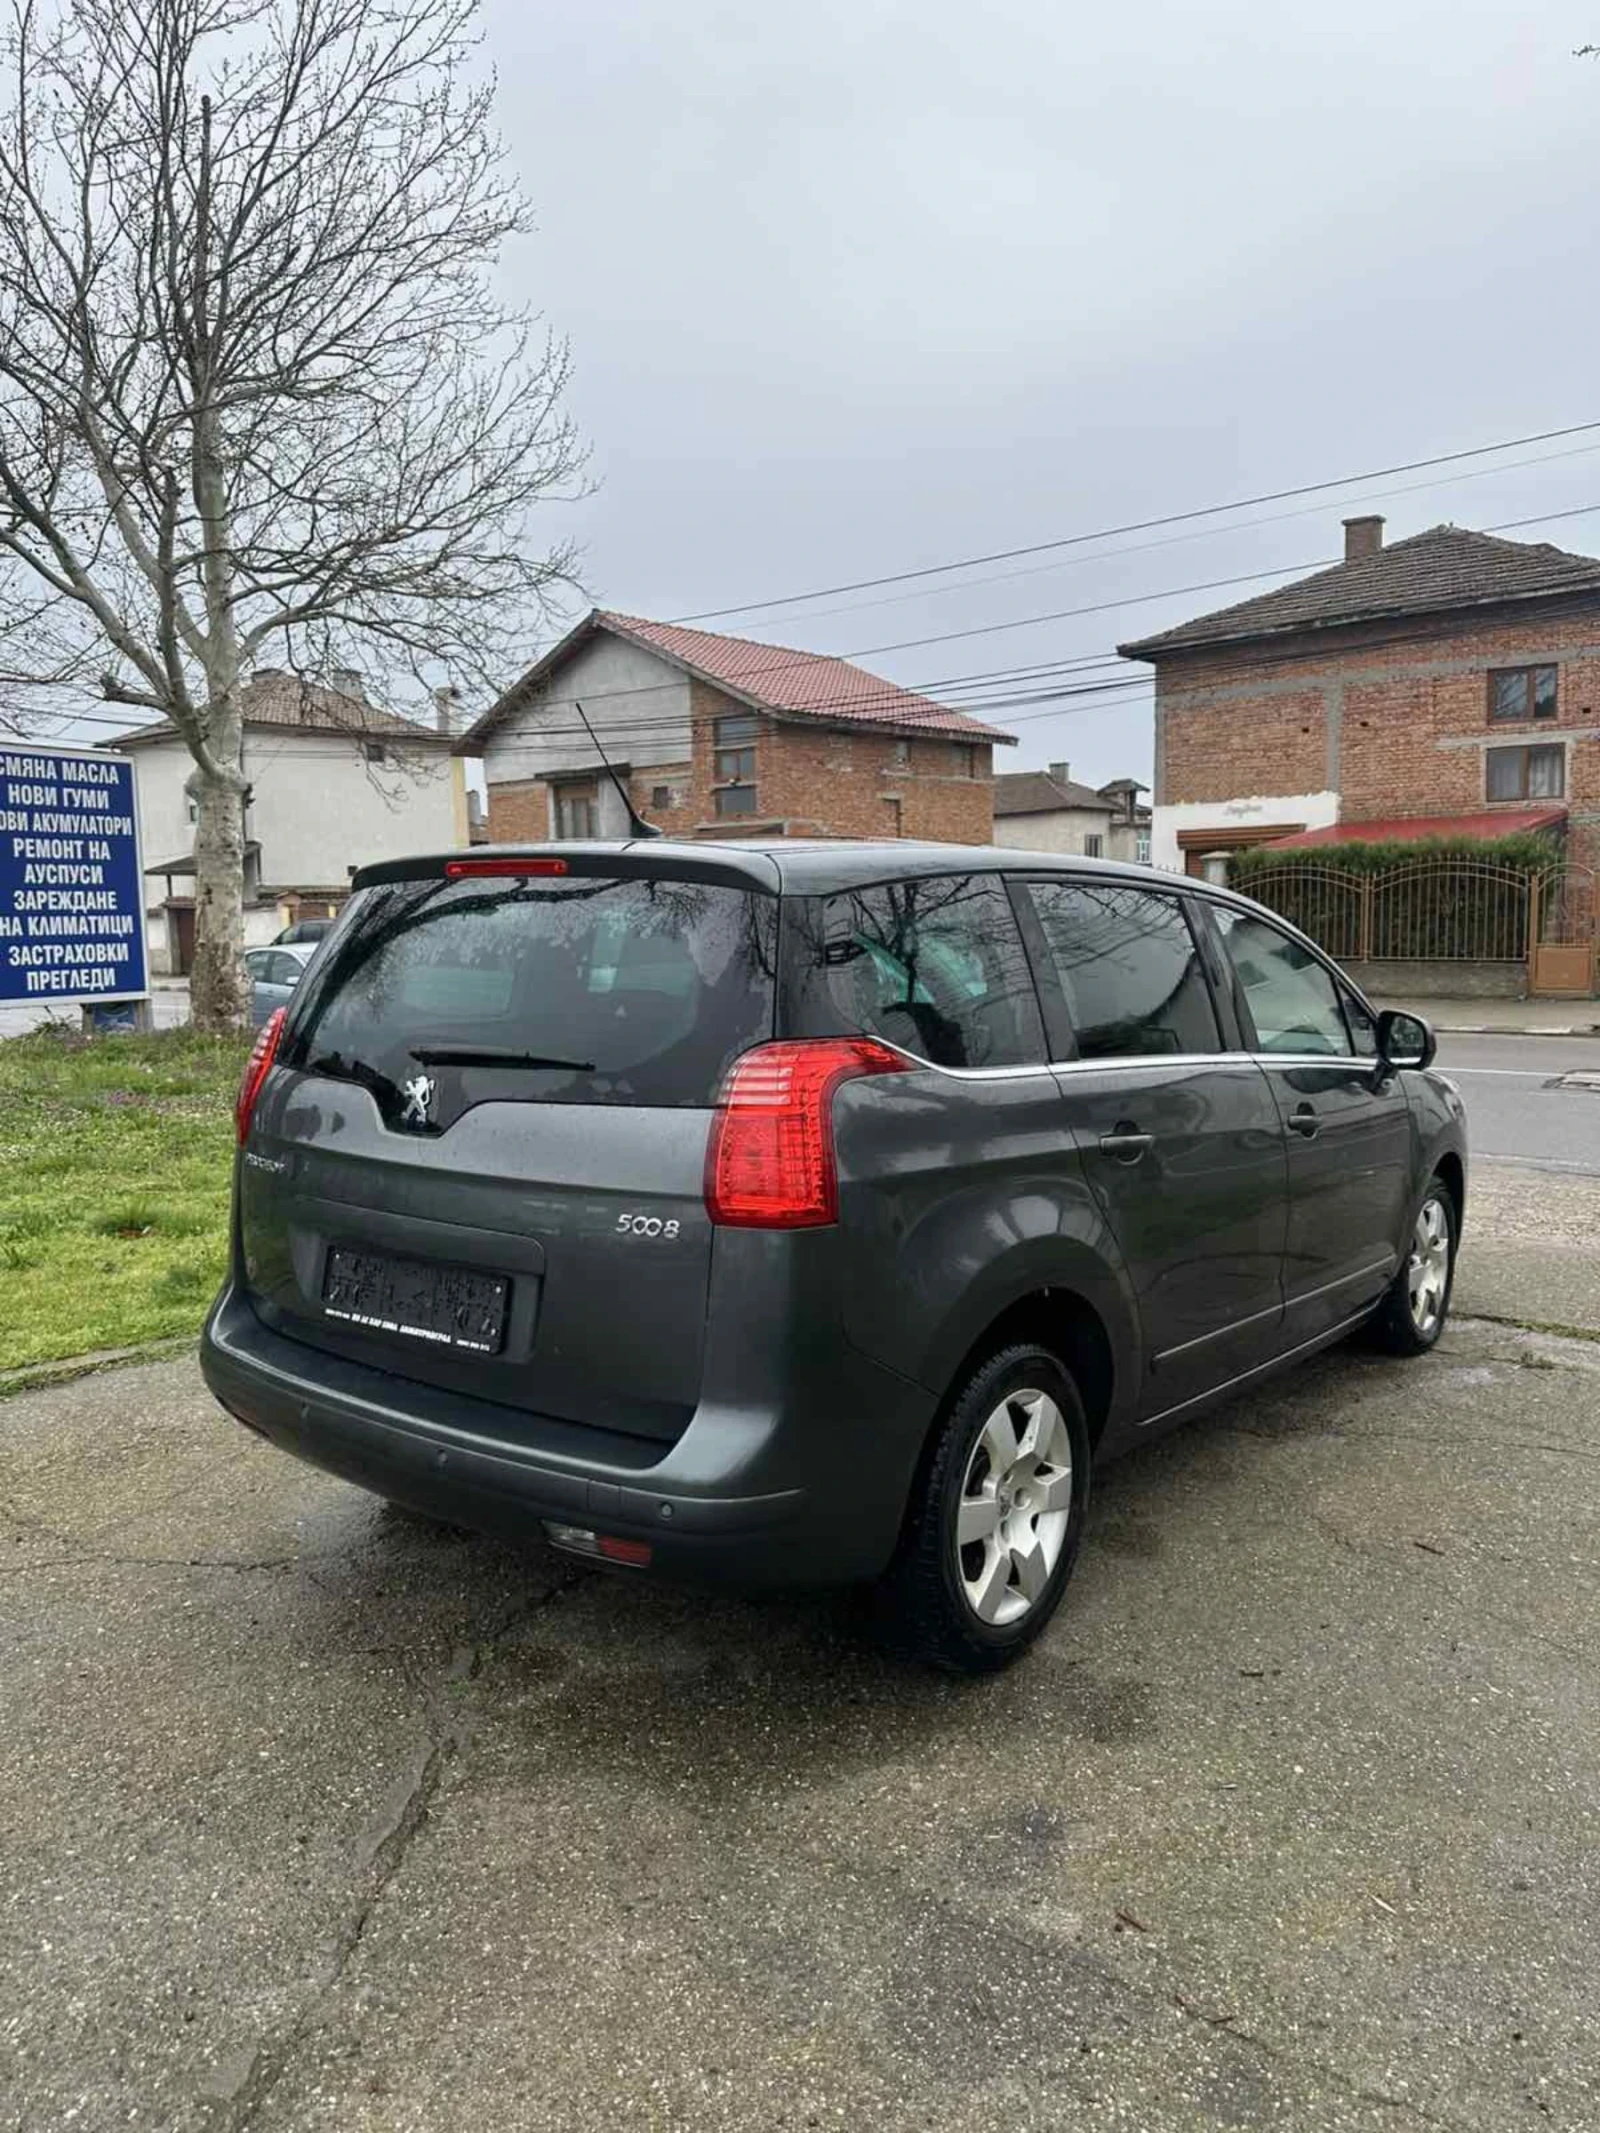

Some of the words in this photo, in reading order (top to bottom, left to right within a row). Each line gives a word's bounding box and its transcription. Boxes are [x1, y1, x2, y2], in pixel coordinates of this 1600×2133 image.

[61, 760, 119, 785] МАСЛА
[8, 783, 57, 807] НОВИ
[63, 787, 110, 810] ГУМИ
[33, 812, 133, 836] АКУМУЛАТОРИ
[13, 837, 84, 860] РЕМОНТ
[89, 840, 111, 861] НА
[24, 863, 104, 885] АУСПУСИ
[13, 890, 118, 914] ЗАРЕЖДАНЕ
[0, 916, 24, 937] НА
[27, 914, 134, 938] КЛИМАТИЦИ
[9, 943, 129, 966] ЗАСТРАХОВКИ
[26, 967, 116, 992] ПРЕГЛЕДИ
[615, 1213, 680, 1239] 5008
